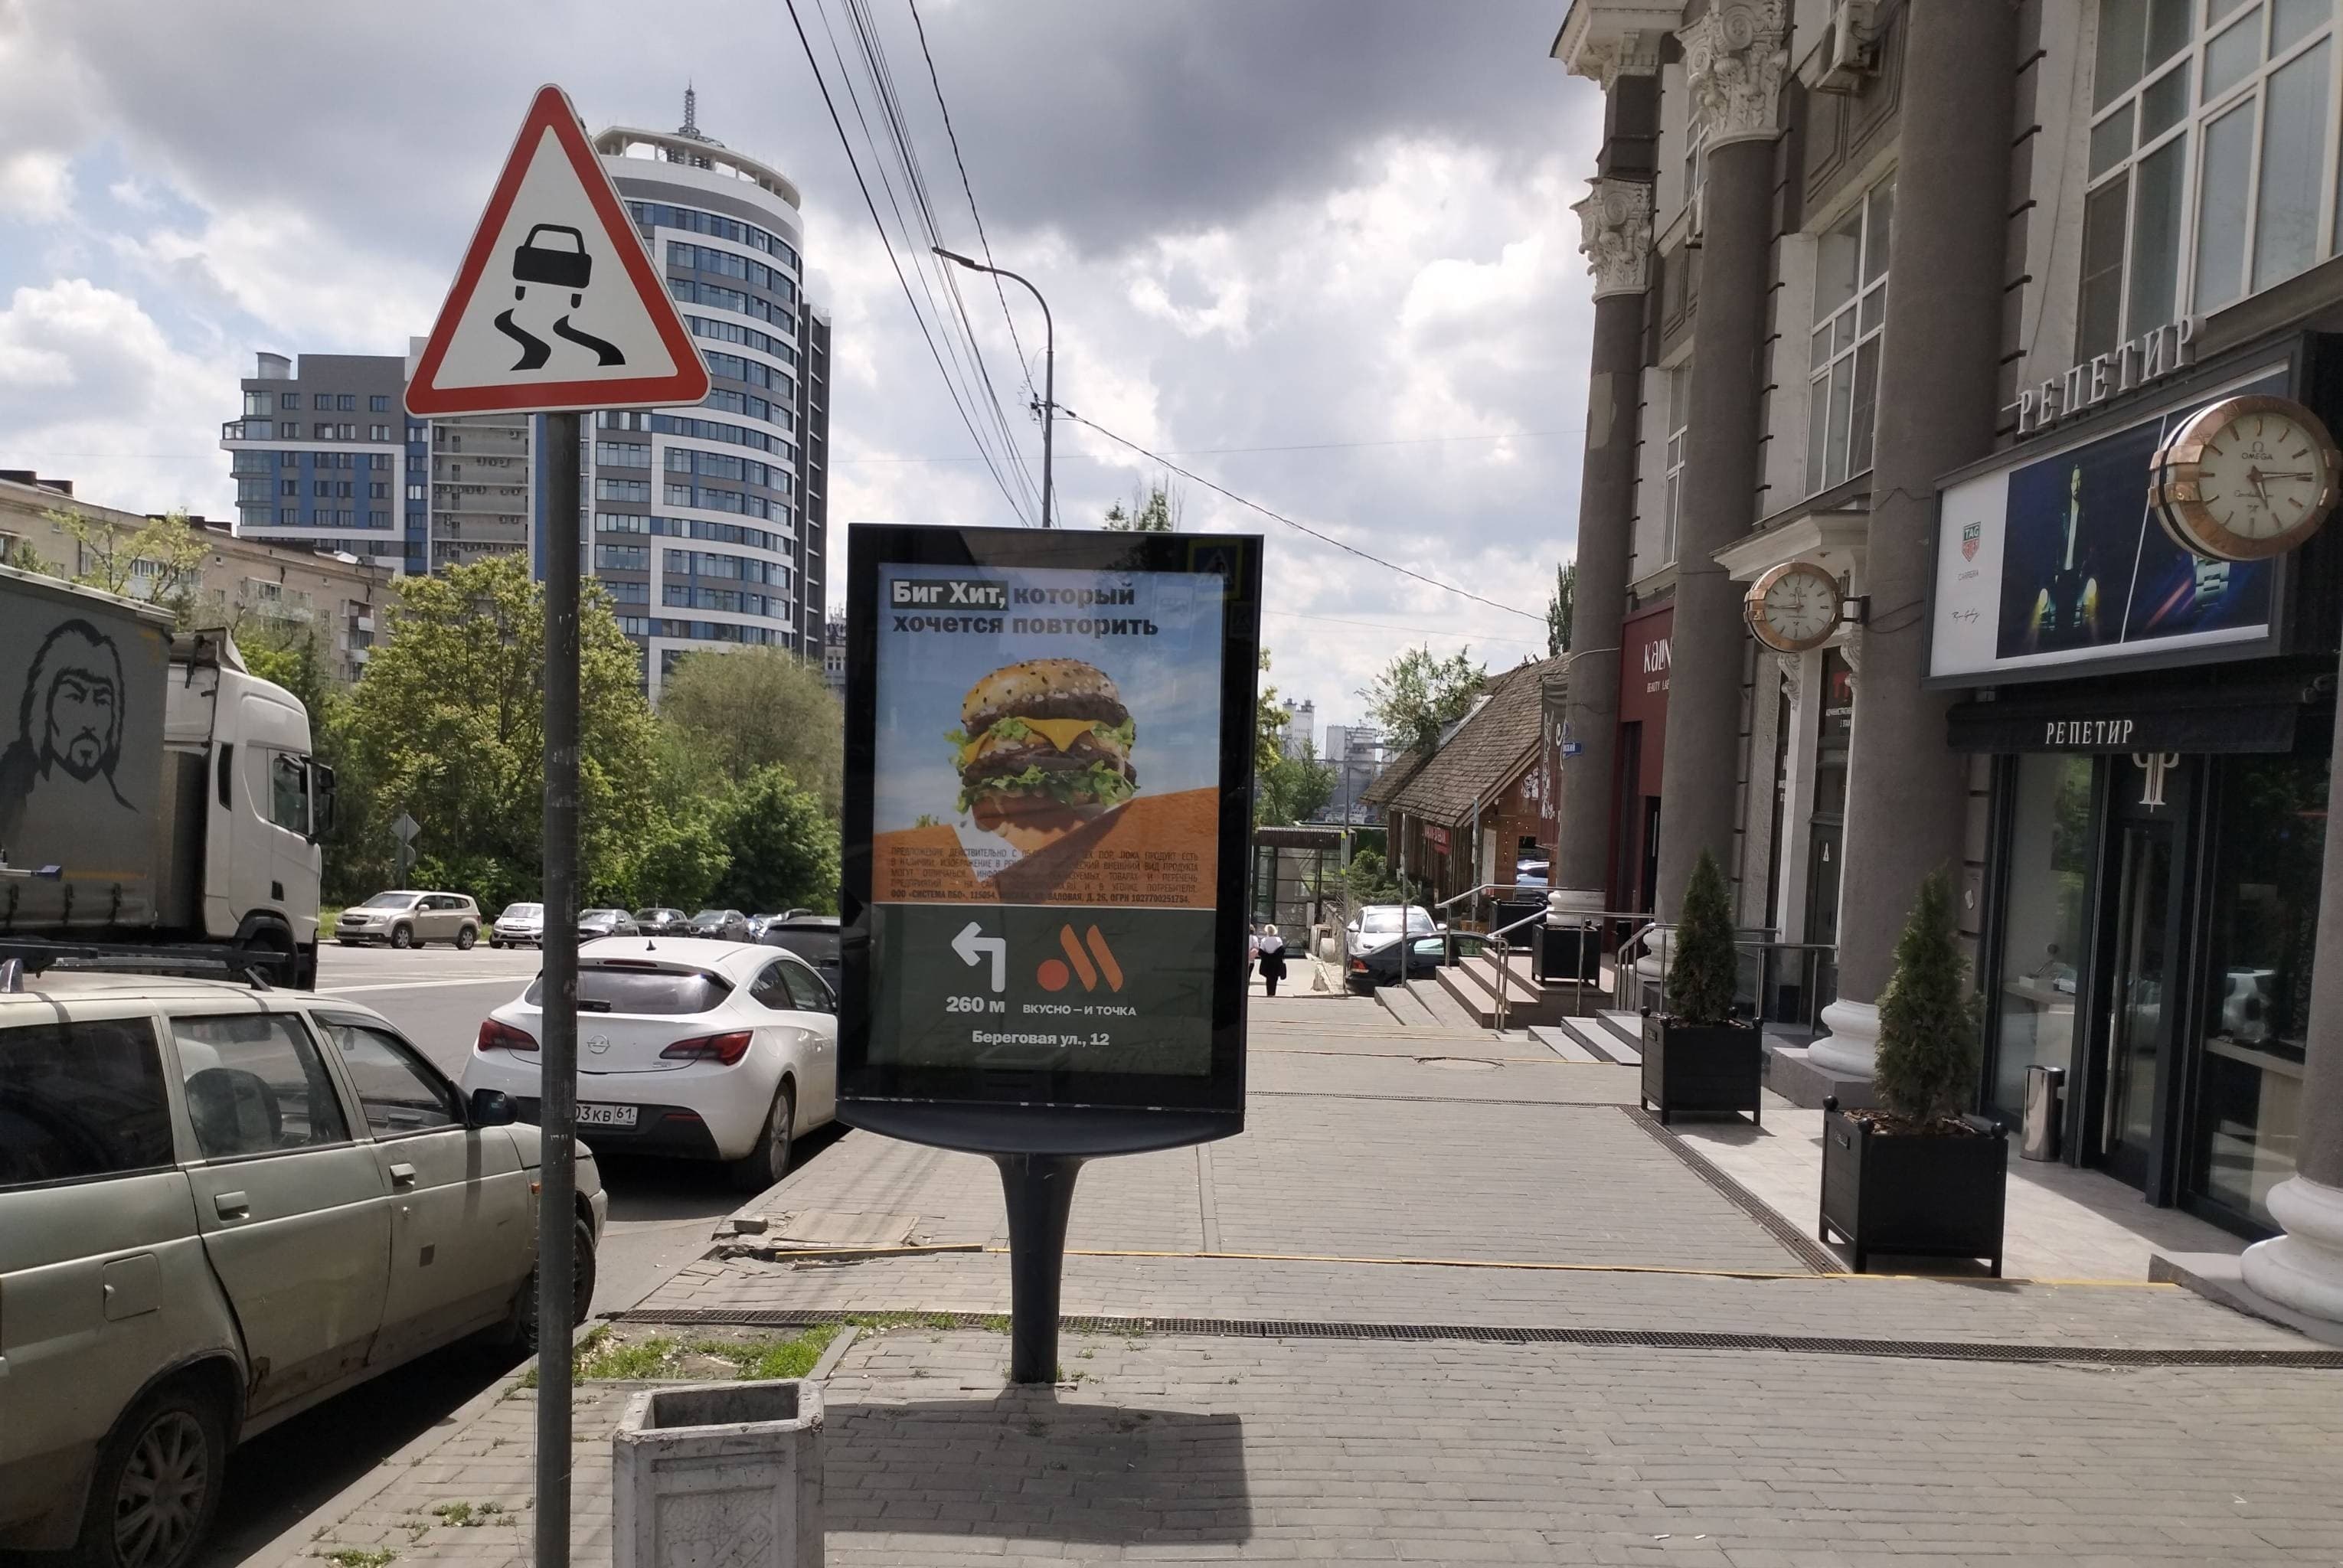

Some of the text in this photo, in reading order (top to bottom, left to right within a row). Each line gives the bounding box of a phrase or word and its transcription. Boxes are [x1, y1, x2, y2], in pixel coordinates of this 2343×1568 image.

[2017, 314, 2198, 435] РЕПЕТИР
[2241, 452, 2273, 460] OMEGA
[1965, 525, 1979, 541] TAG
[893, 580, 1135, 609] Биг Хит, который
[892, 616, 1158, 639] хочется повторить
[1643, 638, 1672, 674] KALIN
[2045, 720, 2133, 744] РЕПЕТИР
[946, 996, 985, 1013] 260
[1022, 1003, 1071, 1014] ВКУСНО
[1096, 1005, 1137, 1017] ТОЧКА
[972, 1030, 1109, 1048] Береговая ул., 12
[616, 1107, 632, 1119] 61
